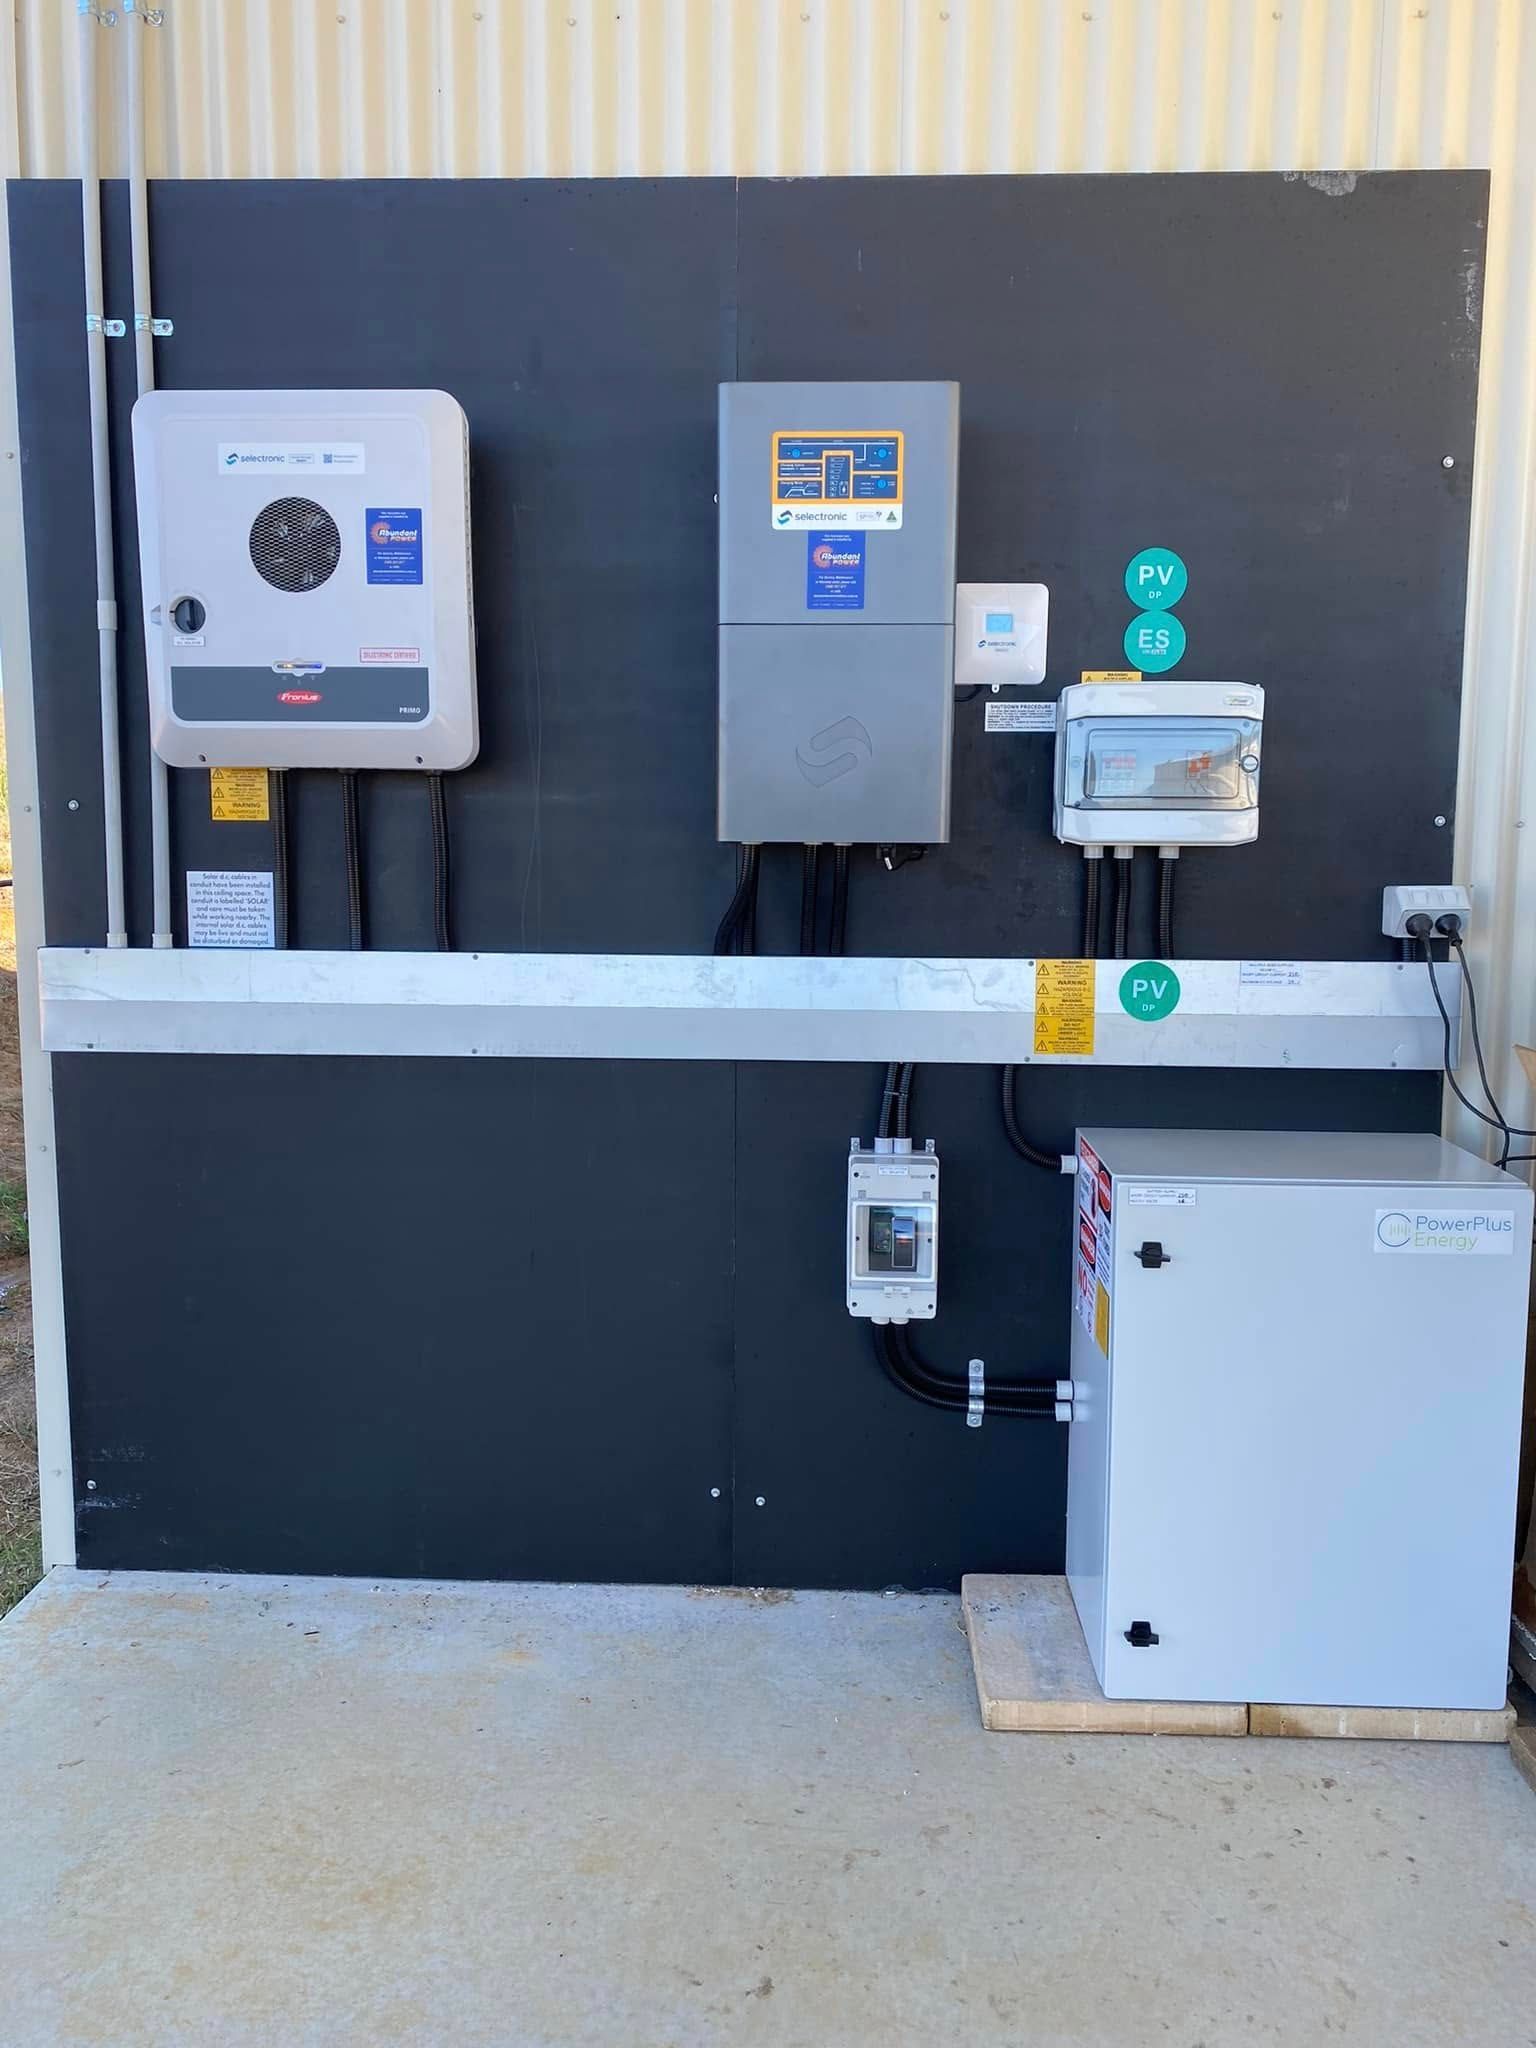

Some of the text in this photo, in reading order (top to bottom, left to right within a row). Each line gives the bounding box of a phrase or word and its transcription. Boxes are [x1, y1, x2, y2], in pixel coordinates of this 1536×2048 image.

[241, 454, 285, 462] selectronic
[794, 512, 847, 521] selectronic
[379, 529, 418, 537] Abundant
[1138, 565, 1175, 586] PV
[1148, 591, 1162, 599] DP
[1138, 628, 1170, 649] ES
[281, 692, 320, 701] Fronius
[399, 706, 421, 714] PRIMO
[1132, 979, 1168, 999] PV
[1142, 1003, 1156, 1012] DP
[1416, 1215, 1513, 1232] PowerPlus
[1414, 1232, 1478, 1251] Energy
